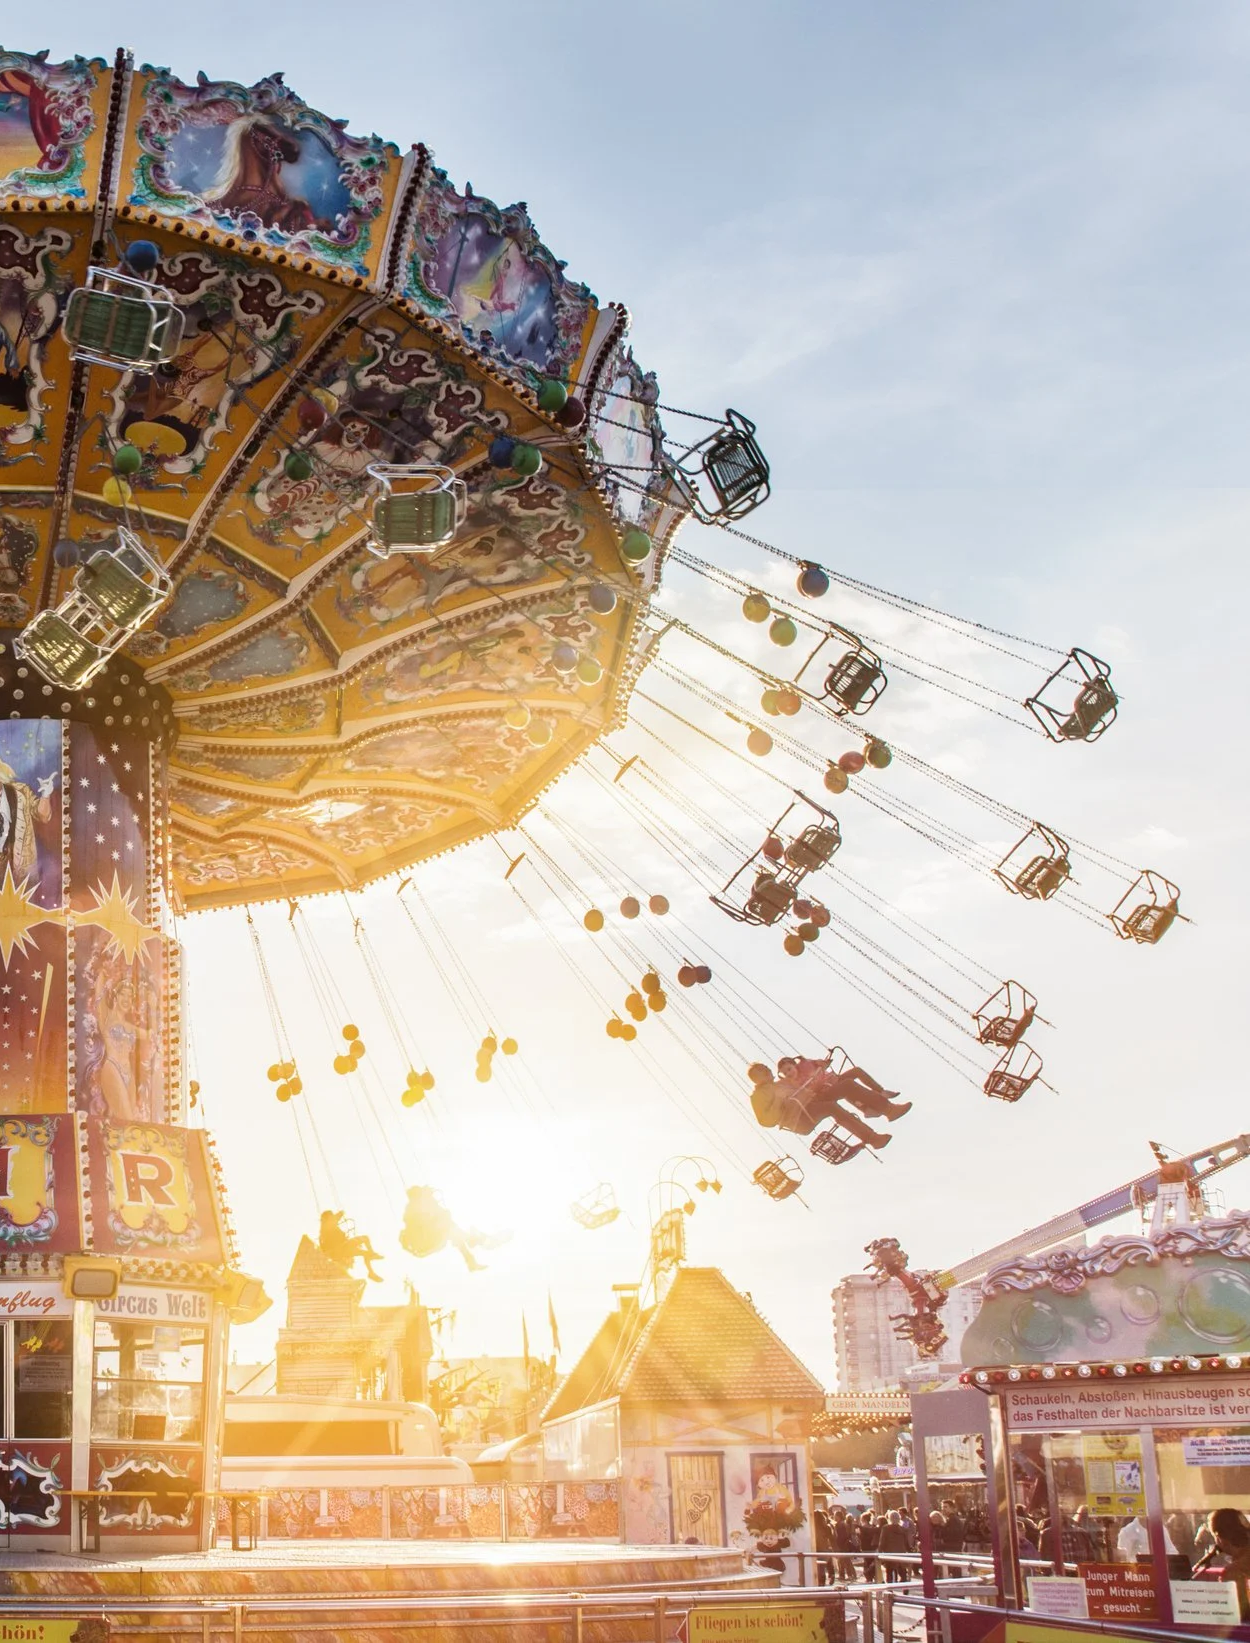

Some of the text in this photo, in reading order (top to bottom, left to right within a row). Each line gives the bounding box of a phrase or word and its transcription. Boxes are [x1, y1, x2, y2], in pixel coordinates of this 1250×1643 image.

[120, 1153, 177, 1207] R
[166, 1293, 207, 1319] Welt
[861, 1400, 910, 1409] MANDELN
[1011, 1393, 1076, 1406] Schaukeln,
[1078, 1390, 1140, 1403] Abstoßen,
[1142, 1388, 1234, 1401] Hinausbeugen
[1013, 1410, 1034, 1422] das
[1036, 1408, 1098, 1421] Festhalten
[1101, 1407, 1121, 1419] der
[1124, 1405, 1206, 1418] Nachbarsitze
[1209, 1403, 1226, 1415] ist
[1086, 1570, 1151, 1584] Junger Mann
[1086, 1586, 1155, 1598] zum Mitreisen
[1103, 1603, 1141, 1615] gesucht
[695, 1613, 803, 1633] Fliegen ist schön!
